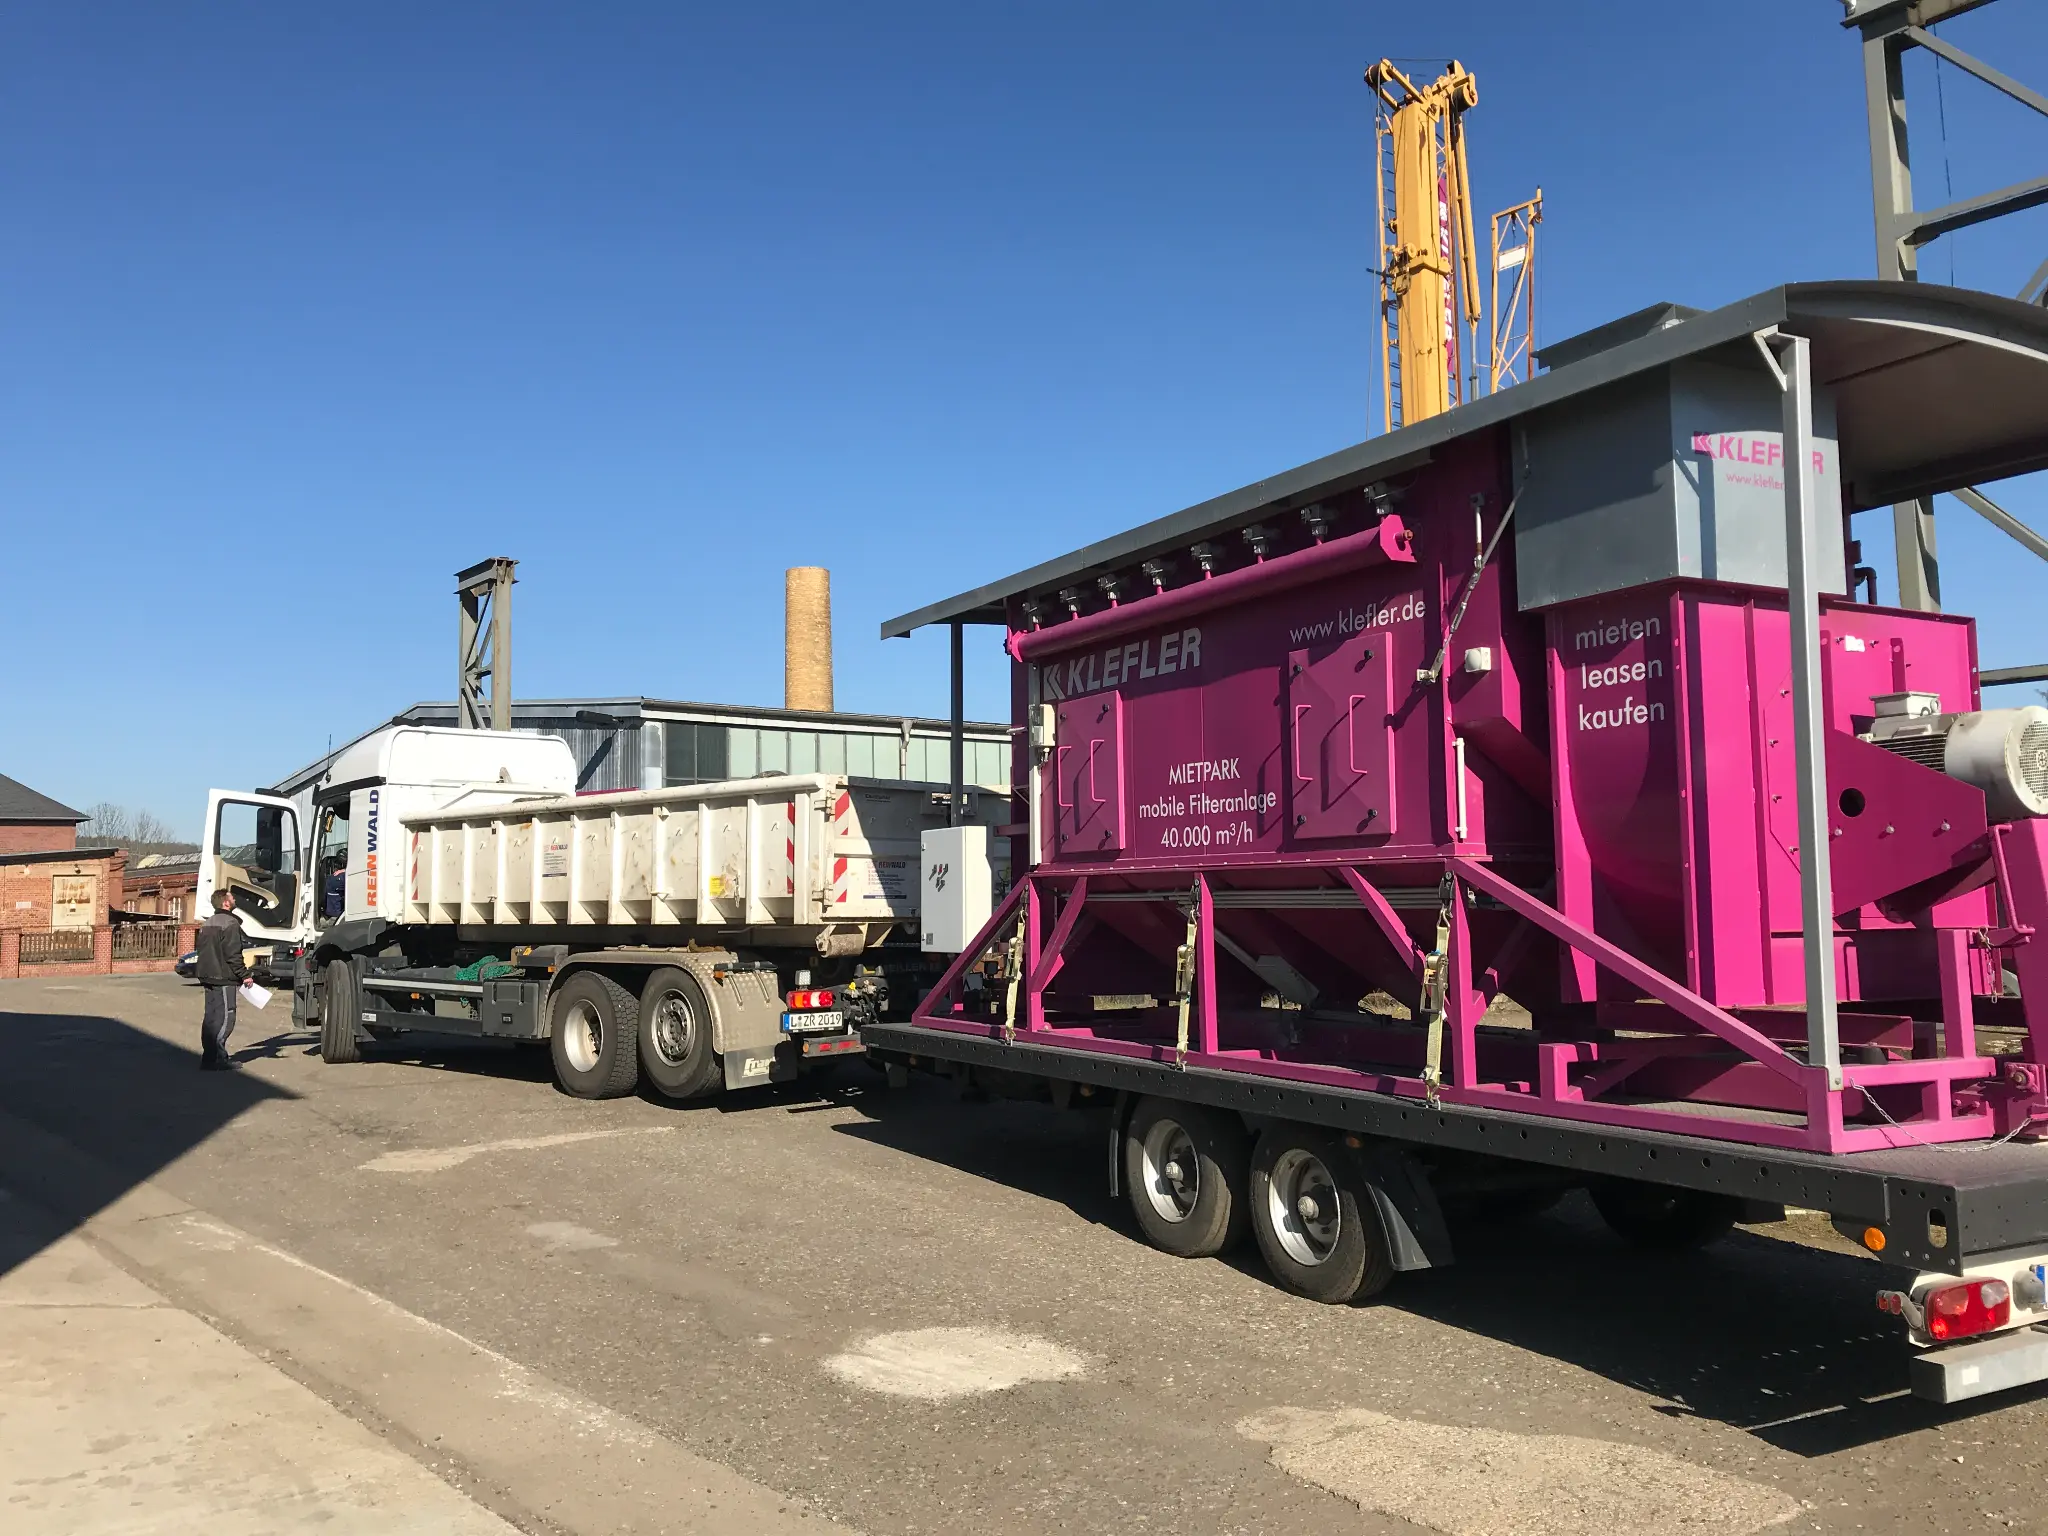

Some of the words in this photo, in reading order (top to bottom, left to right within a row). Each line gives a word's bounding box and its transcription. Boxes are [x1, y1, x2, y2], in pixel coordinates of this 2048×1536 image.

[1719, 434, 1824, 475] KLEFR
[1575, 617, 1661, 650] mieten
[1067, 627, 1202, 696] KLEFLER
[1581, 658, 1663, 690] leasen
[1579, 696, 1665, 731] kaufen
[1168, 757, 1241, 786] MIETPARK
[1139, 795, 1185, 818] mobile
[1189, 788, 1277, 814] Filteranlage
[1160, 824, 1211, 848] 40.000
[817, 1013, 842, 1026] 2019
